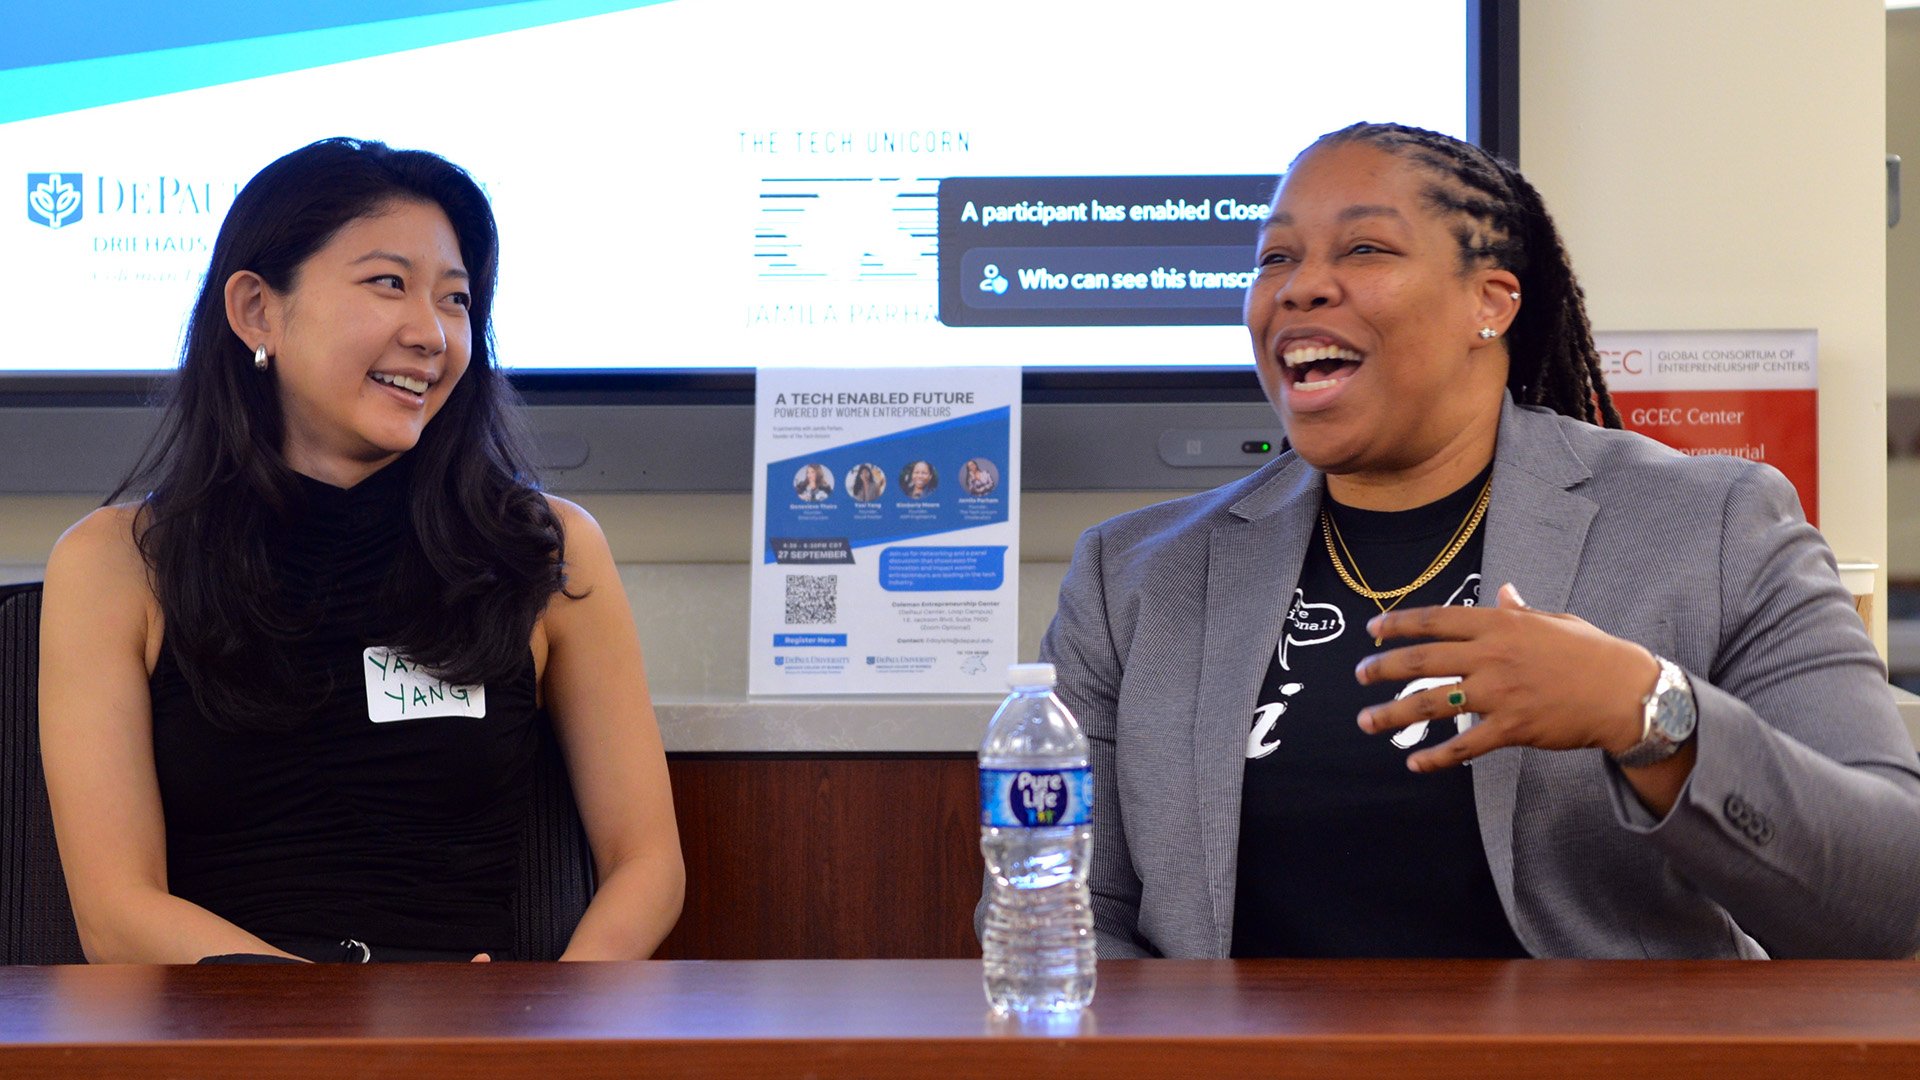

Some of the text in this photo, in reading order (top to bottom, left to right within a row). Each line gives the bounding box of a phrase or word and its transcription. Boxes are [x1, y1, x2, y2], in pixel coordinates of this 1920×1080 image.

[740, 131, 970, 153] THE TECH UNICORN
[961, 201, 979, 222] A
[982, 201, 1088, 227] participant
[1092, 199, 1126, 221] has
[1129, 198, 1210, 221] enabled
[1018, 267, 1069, 290] Who
[1071, 273, 1109, 290] can
[1112, 272, 1148, 289] see
[1150, 266, 1187, 289] this
[850, 304, 940, 325] PARHA
[1658, 350, 1794, 360] GLOBAL CONSORTIUM OF
[1658, 361, 1810, 373] ENTREPRENEURSHIP CENTERS
[775, 392, 975, 405] A TECH ENABLED FUTURE
[774, 406, 951, 418] POWERED BY WOMEN ENTREPRENEURS
[1631, 408, 1744, 425] GCEC Center
[778, 550, 847, 559] 27 SEPTEMBER
[784, 636, 817, 645] Register
[384, 681, 470, 714] YANG
[1017, 771, 1062, 791] Pure
[1023, 788, 1058, 812] Life
